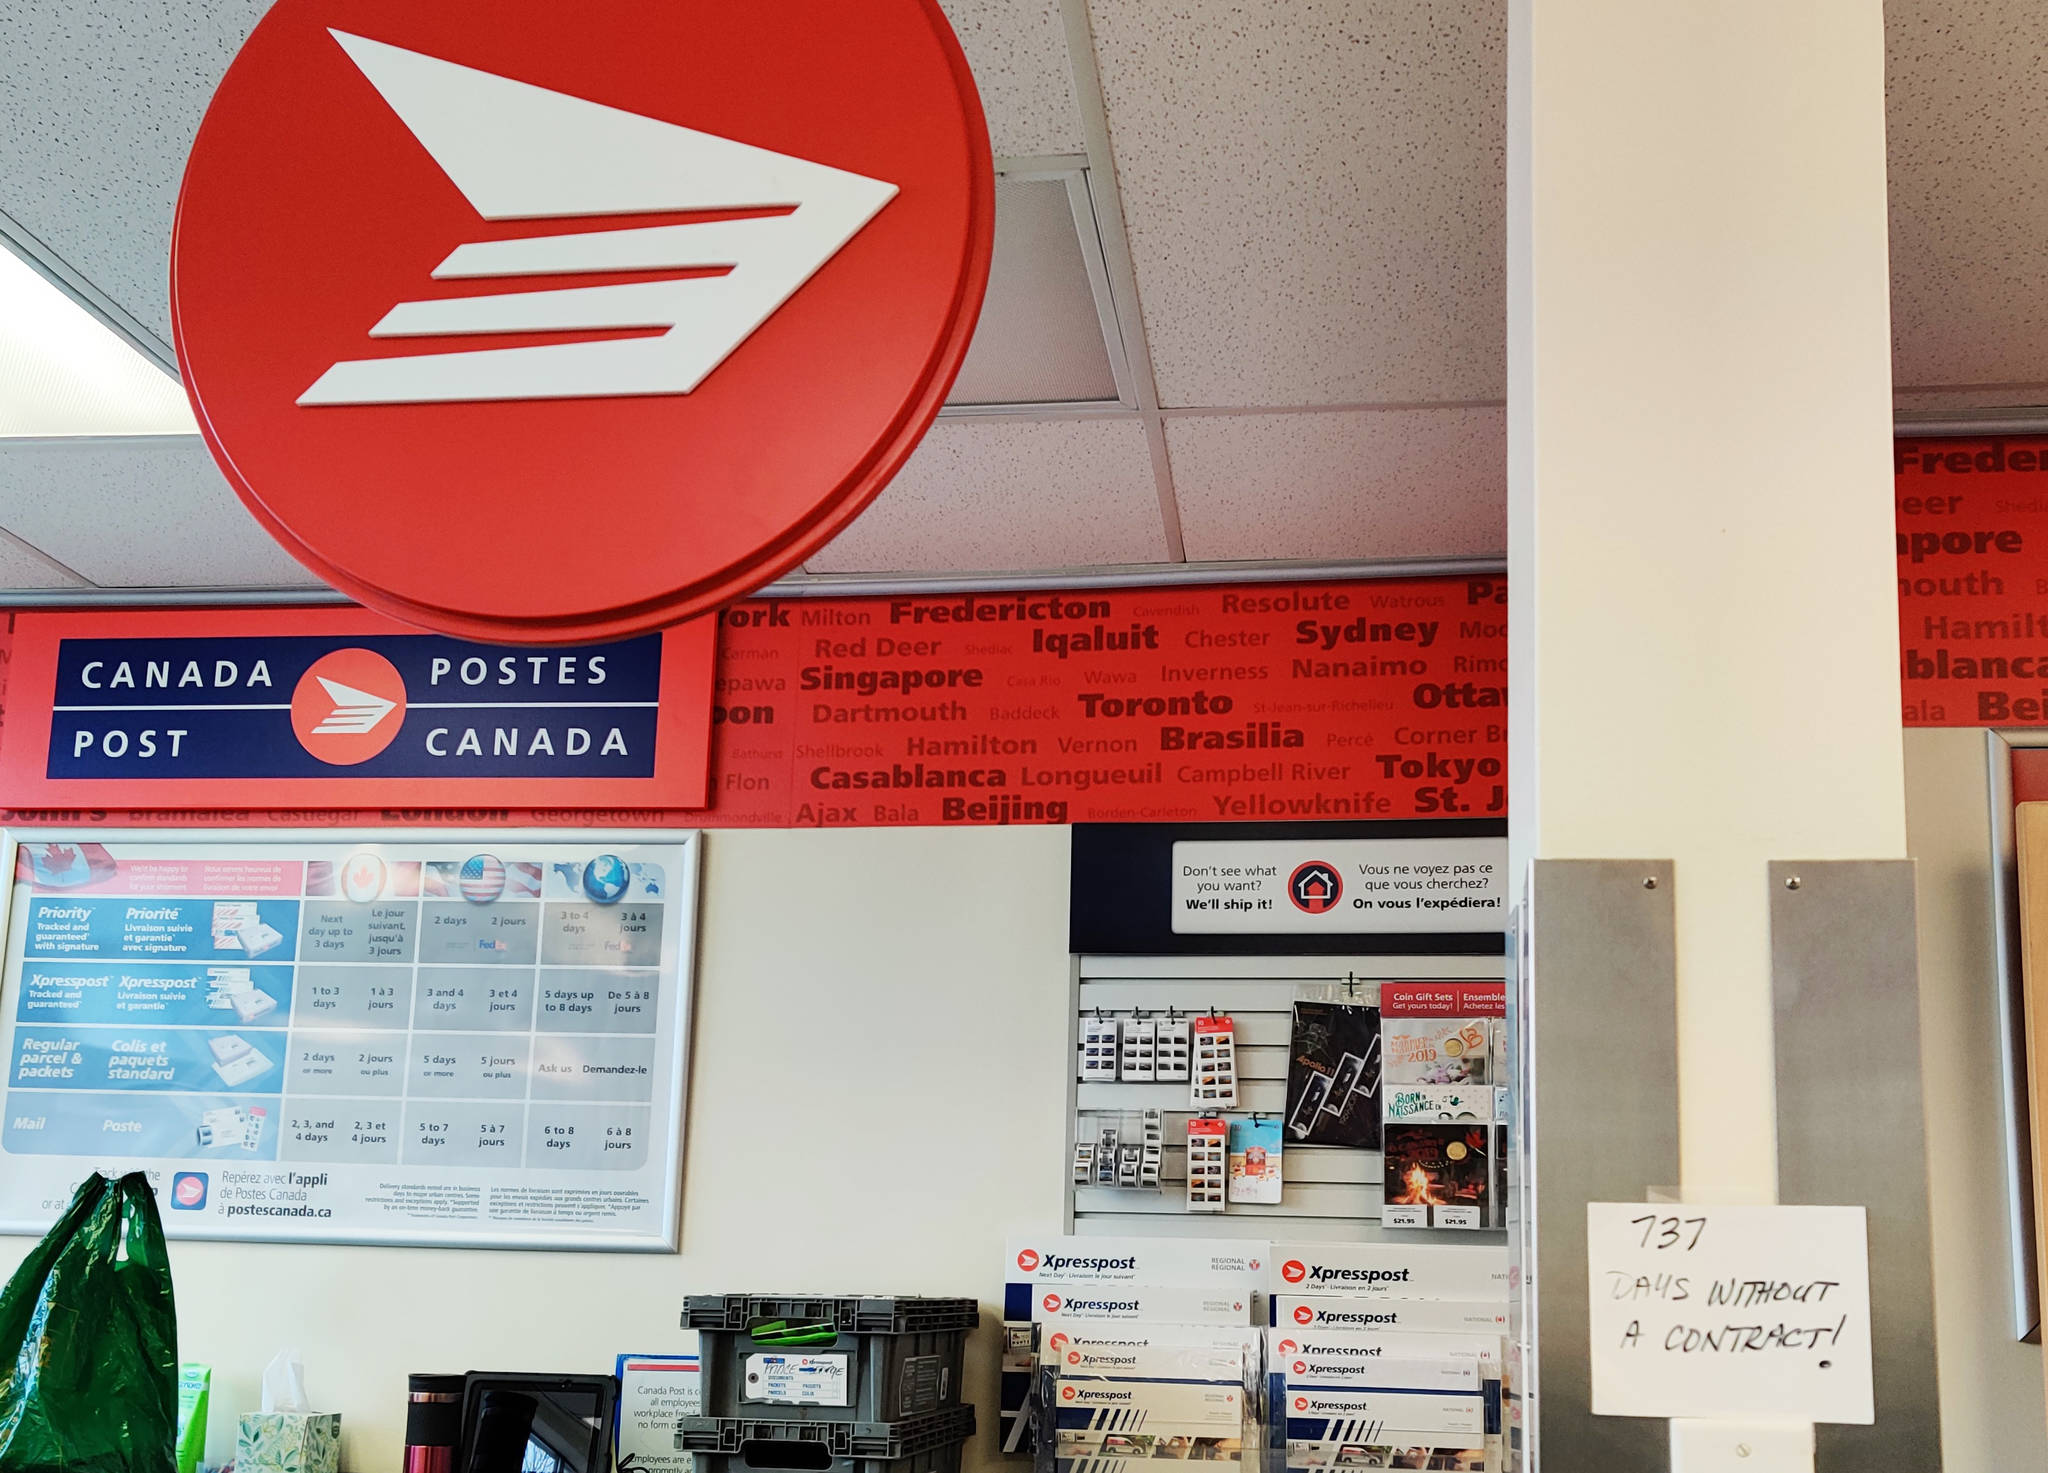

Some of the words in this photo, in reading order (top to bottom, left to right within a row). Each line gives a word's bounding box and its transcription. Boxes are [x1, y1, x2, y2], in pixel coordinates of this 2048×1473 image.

[1222, 592, 1350, 614] Resolute
[1370, 595, 1445, 609] Watrous
[801, 608, 871, 626] Milton
[890, 595, 1111, 625] Fredericton
[1133, 605, 1200, 618] Cavendish
[1185, 630, 1271, 649] Chester
[1296, 617, 1440, 651] Sydney
[815, 638, 867, 659] Red
[876, 638, 942, 657] Deer
[1033, 623, 1159, 660] Iqaluit
[82, 660, 273, 689] CANADA
[430, 656, 607, 686] POSTES
[1161, 663, 1269, 682] Inverness
[1292, 657, 1428, 679] Nanaimo
[801, 666, 983, 697] Singapore
[1084, 670, 1137, 685] Wawa
[1078, 691, 1233, 719] Toronto
[813, 702, 968, 724] Dartmouth
[990, 706, 1061, 721] Baddeck
[426, 727, 628, 757] CANADA
[1160, 722, 1304, 752] Brasilia
[1394, 726, 1478, 746] Corner
[74, 730, 188, 758] POST
[907, 734, 1037, 757] Hamilton
[1058, 737, 1138, 754] Vernon
[796, 744, 883, 760] Shellbrook
[1178, 763, 1284, 786] Campbell
[1291, 763, 1352, 781] River
[1376, 752, 1501, 785] Tokyo
[726, 772, 770, 791] Flon
[811, 763, 1006, 790] Casablanca
[1021, 762, 1162, 791] Longueuil
[1213, 792, 1392, 817] Yellowknife
[1414, 786, 1470, 813] St.
[796, 803, 858, 828] Ajax
[874, 804, 919, 823] Bala
[942, 796, 1068, 825] Beijing
[1183, 866, 1218, 877] Don't
[1221, 868, 1241, 876] see
[1245, 866, 1277, 876] what
[1359, 864, 1389, 875] Vous
[1394, 866, 1409, 874] ne
[1414, 866, 1449, 878] voyez
[1453, 865, 1476, 877] pas
[1479, 865, 1493, 873] ce
[1198, 882, 1221, 894] you
[1224, 880, 1261, 891] want?
[1365, 881, 1389, 892] que
[1393, 881, 1423, 889] vous
[1427, 877, 1489, 889] cherchez?
[1187, 899, 1219, 910] We'll
[1224, 900, 1252, 913] ship
[1258, 899, 1272, 910] it!
[1353, 899, 1372, 909] On
[1377, 900, 1412, 908] vous
[1416, 897, 1501, 911] l'expédiera!
[38, 907, 91, 921] Priority
[126, 908, 179, 920] Priorité
[37, 923, 68, 931] Tracked
[70, 923, 89, 931] and
[125, 924, 161, 932] Livraison
[163, 924, 193, 932] suivie
[35, 942, 54, 950] with
[57, 943, 99, 952] signature
[123, 944, 140, 952] avec
[143, 944, 187, 952] signature
[30, 975, 109, 988] Xpresspost
[119, 975, 197, 989] Xpresspost
[545, 990, 550, 999] 5
[554, 990, 577, 1001] days
[581, 991, 593, 1001] up
[608, 991, 621, 999] De
[624, 991, 630, 999] 5
[643, 991, 649, 1000] 8
[1394, 993, 1413, 1001] Coin
[1416, 993, 1433, 1001] Gift
[545, 1004, 555, 1012] to
[558, 1003, 565, 1012] 8
[568, 1003, 592, 1014] days
[614, 1004, 641, 1015] jours
[22, 1039, 80, 1052] Regular
[112, 1040, 147, 1052] Colis
[151, 1040, 166, 1052] et
[21, 1052, 68, 1066] parcel
[71, 1054, 82, 1064] &
[109, 1055, 168, 1069] paquets
[1408, 1049, 1437, 1062] 2019
[19, 1065, 74, 1079] packets
[108, 1068, 174, 1080] standard
[582, 1064, 647, 1075] Demandez-le
[14, 1117, 45, 1130] Mail
[103, 1120, 141, 1132] Poste
[545, 1126, 551, 1135] 6
[554, 1126, 564, 1135] to
[568, 1126, 574, 1135] 8
[547, 1138, 571, 1149] days
[222, 1171, 261, 1184] Repérez
[263, 1174, 286, 1184] avec
[289, 1172, 328, 1186] l'appli
[220, 1188, 232, 1198] de
[236, 1188, 266, 1200] Postes
[270, 1189, 307, 1201] Canada
[219, 1203, 224, 1214] à
[227, 1204, 331, 1219] postescanada.ca
[1632, 1215, 1706, 1251] 737
[1043, 1254, 1135, 1272] Xpresspost
[1309, 1266, 1410, 1283] Xpresspost
[1606, 1271, 1690, 1300] DAYS
[1708, 1278, 1839, 1308] WITHOUT
[1064, 1299, 1139, 1312] Xpresspost
[1316, 1311, 1397, 1325] Xpresspost
[1621, 1320, 1644, 1348] A
[1082, 1355, 1136, 1365] Xpresspost
[1309, 1364, 1365, 1375] Xpresspost
[638, 1386, 666, 1395] Canada
[670, 1387, 684, 1395] Post
[1077, 1390, 1131, 1400] Xpresspost
[1311, 1400, 1366, 1412] Xpresspost
[634, 1409, 673, 1418] workplace
[651, 1421, 668, 1429] form
